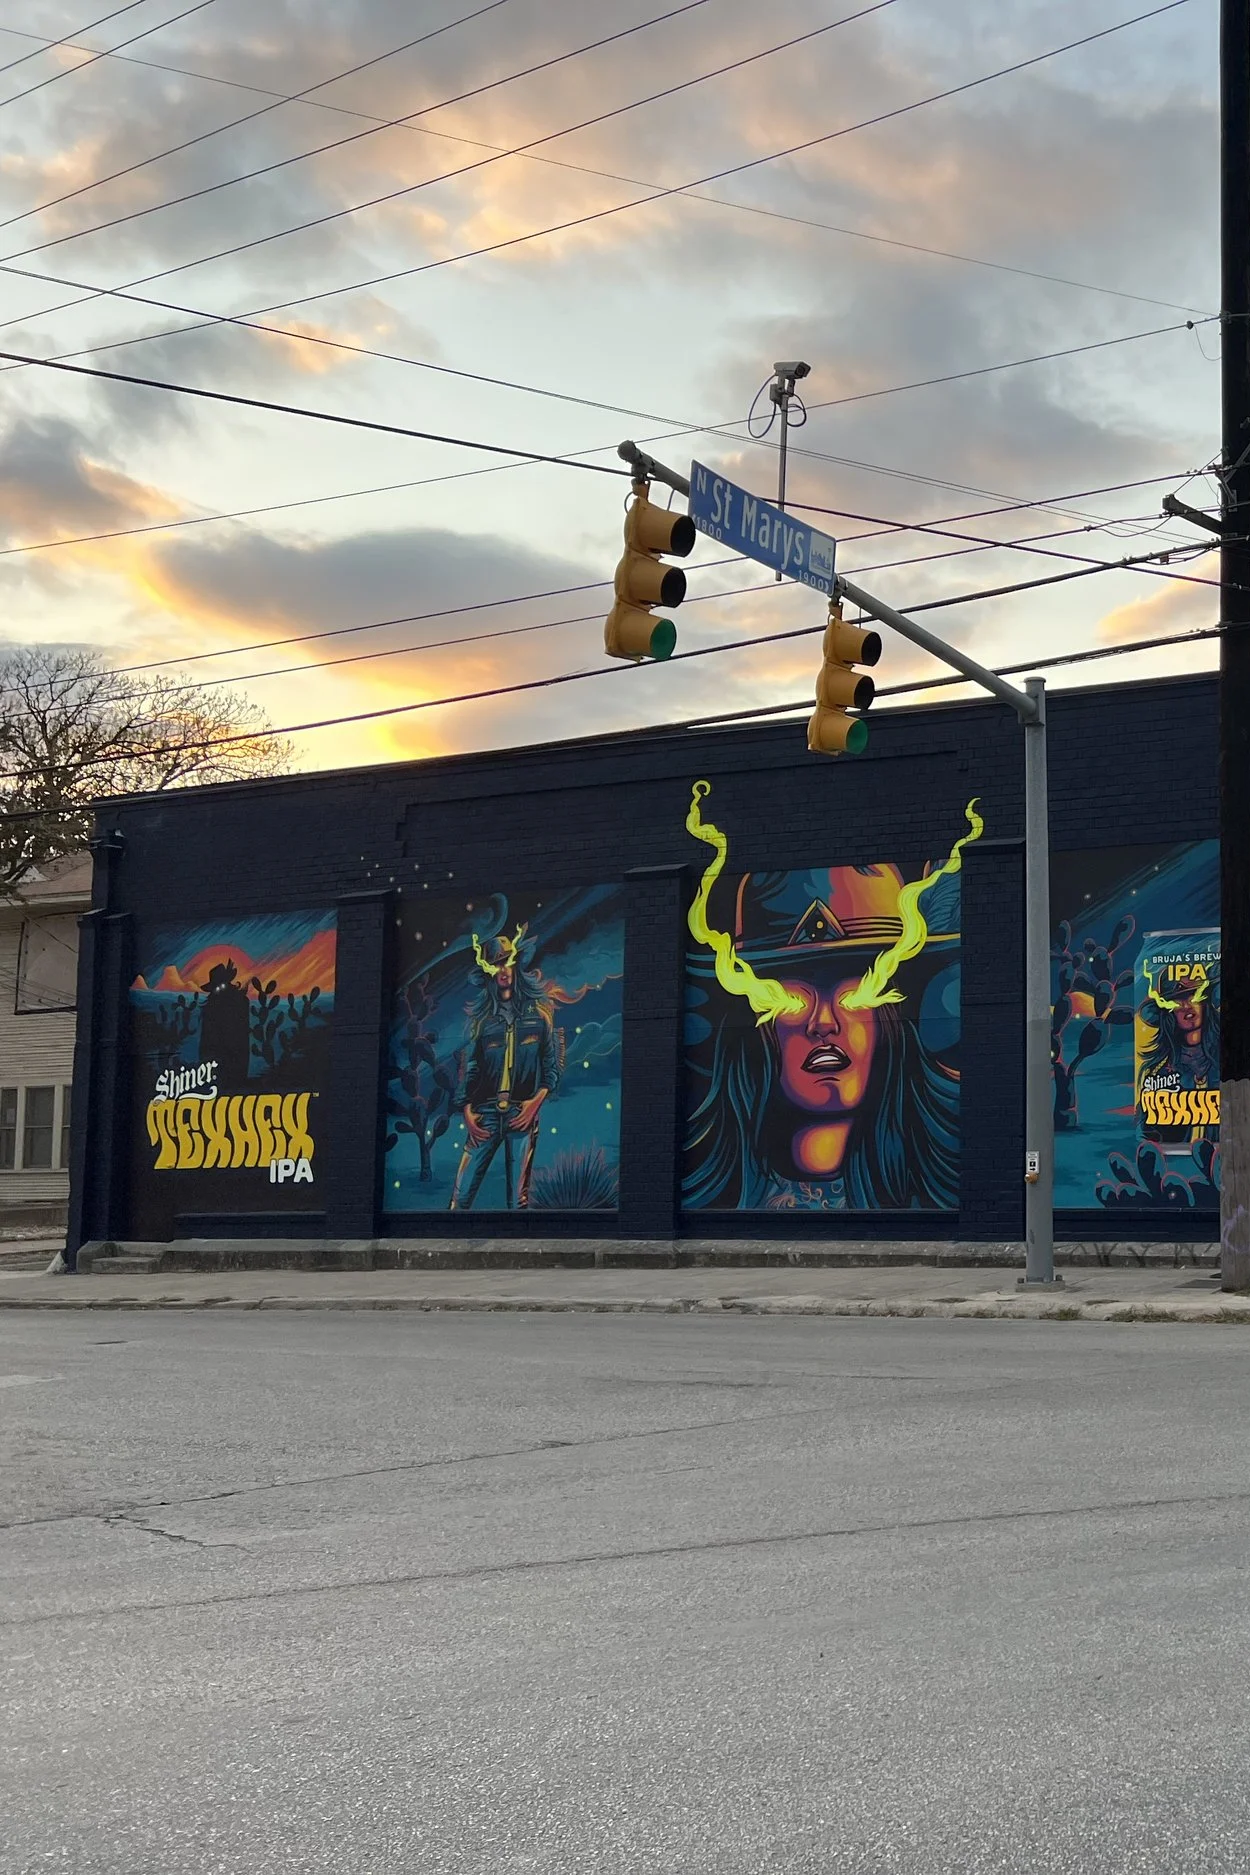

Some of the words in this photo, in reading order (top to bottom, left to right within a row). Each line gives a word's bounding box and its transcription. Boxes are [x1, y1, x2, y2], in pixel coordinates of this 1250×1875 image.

[696, 515, 722, 540] 1800
[697, 468, 707, 495] N
[711, 478, 733, 530] St
[741, 495, 805, 570] Marys
[799, 570, 825, 590] 1900
[1152, 953, 1191, 964] BRUJA'S
[1168, 963, 1207, 981] IPA
[1141, 1090, 1221, 1125] TEXHE
[147, 1092, 315, 1169] TEXHEX
[269, 1158, 314, 1184] IPA
